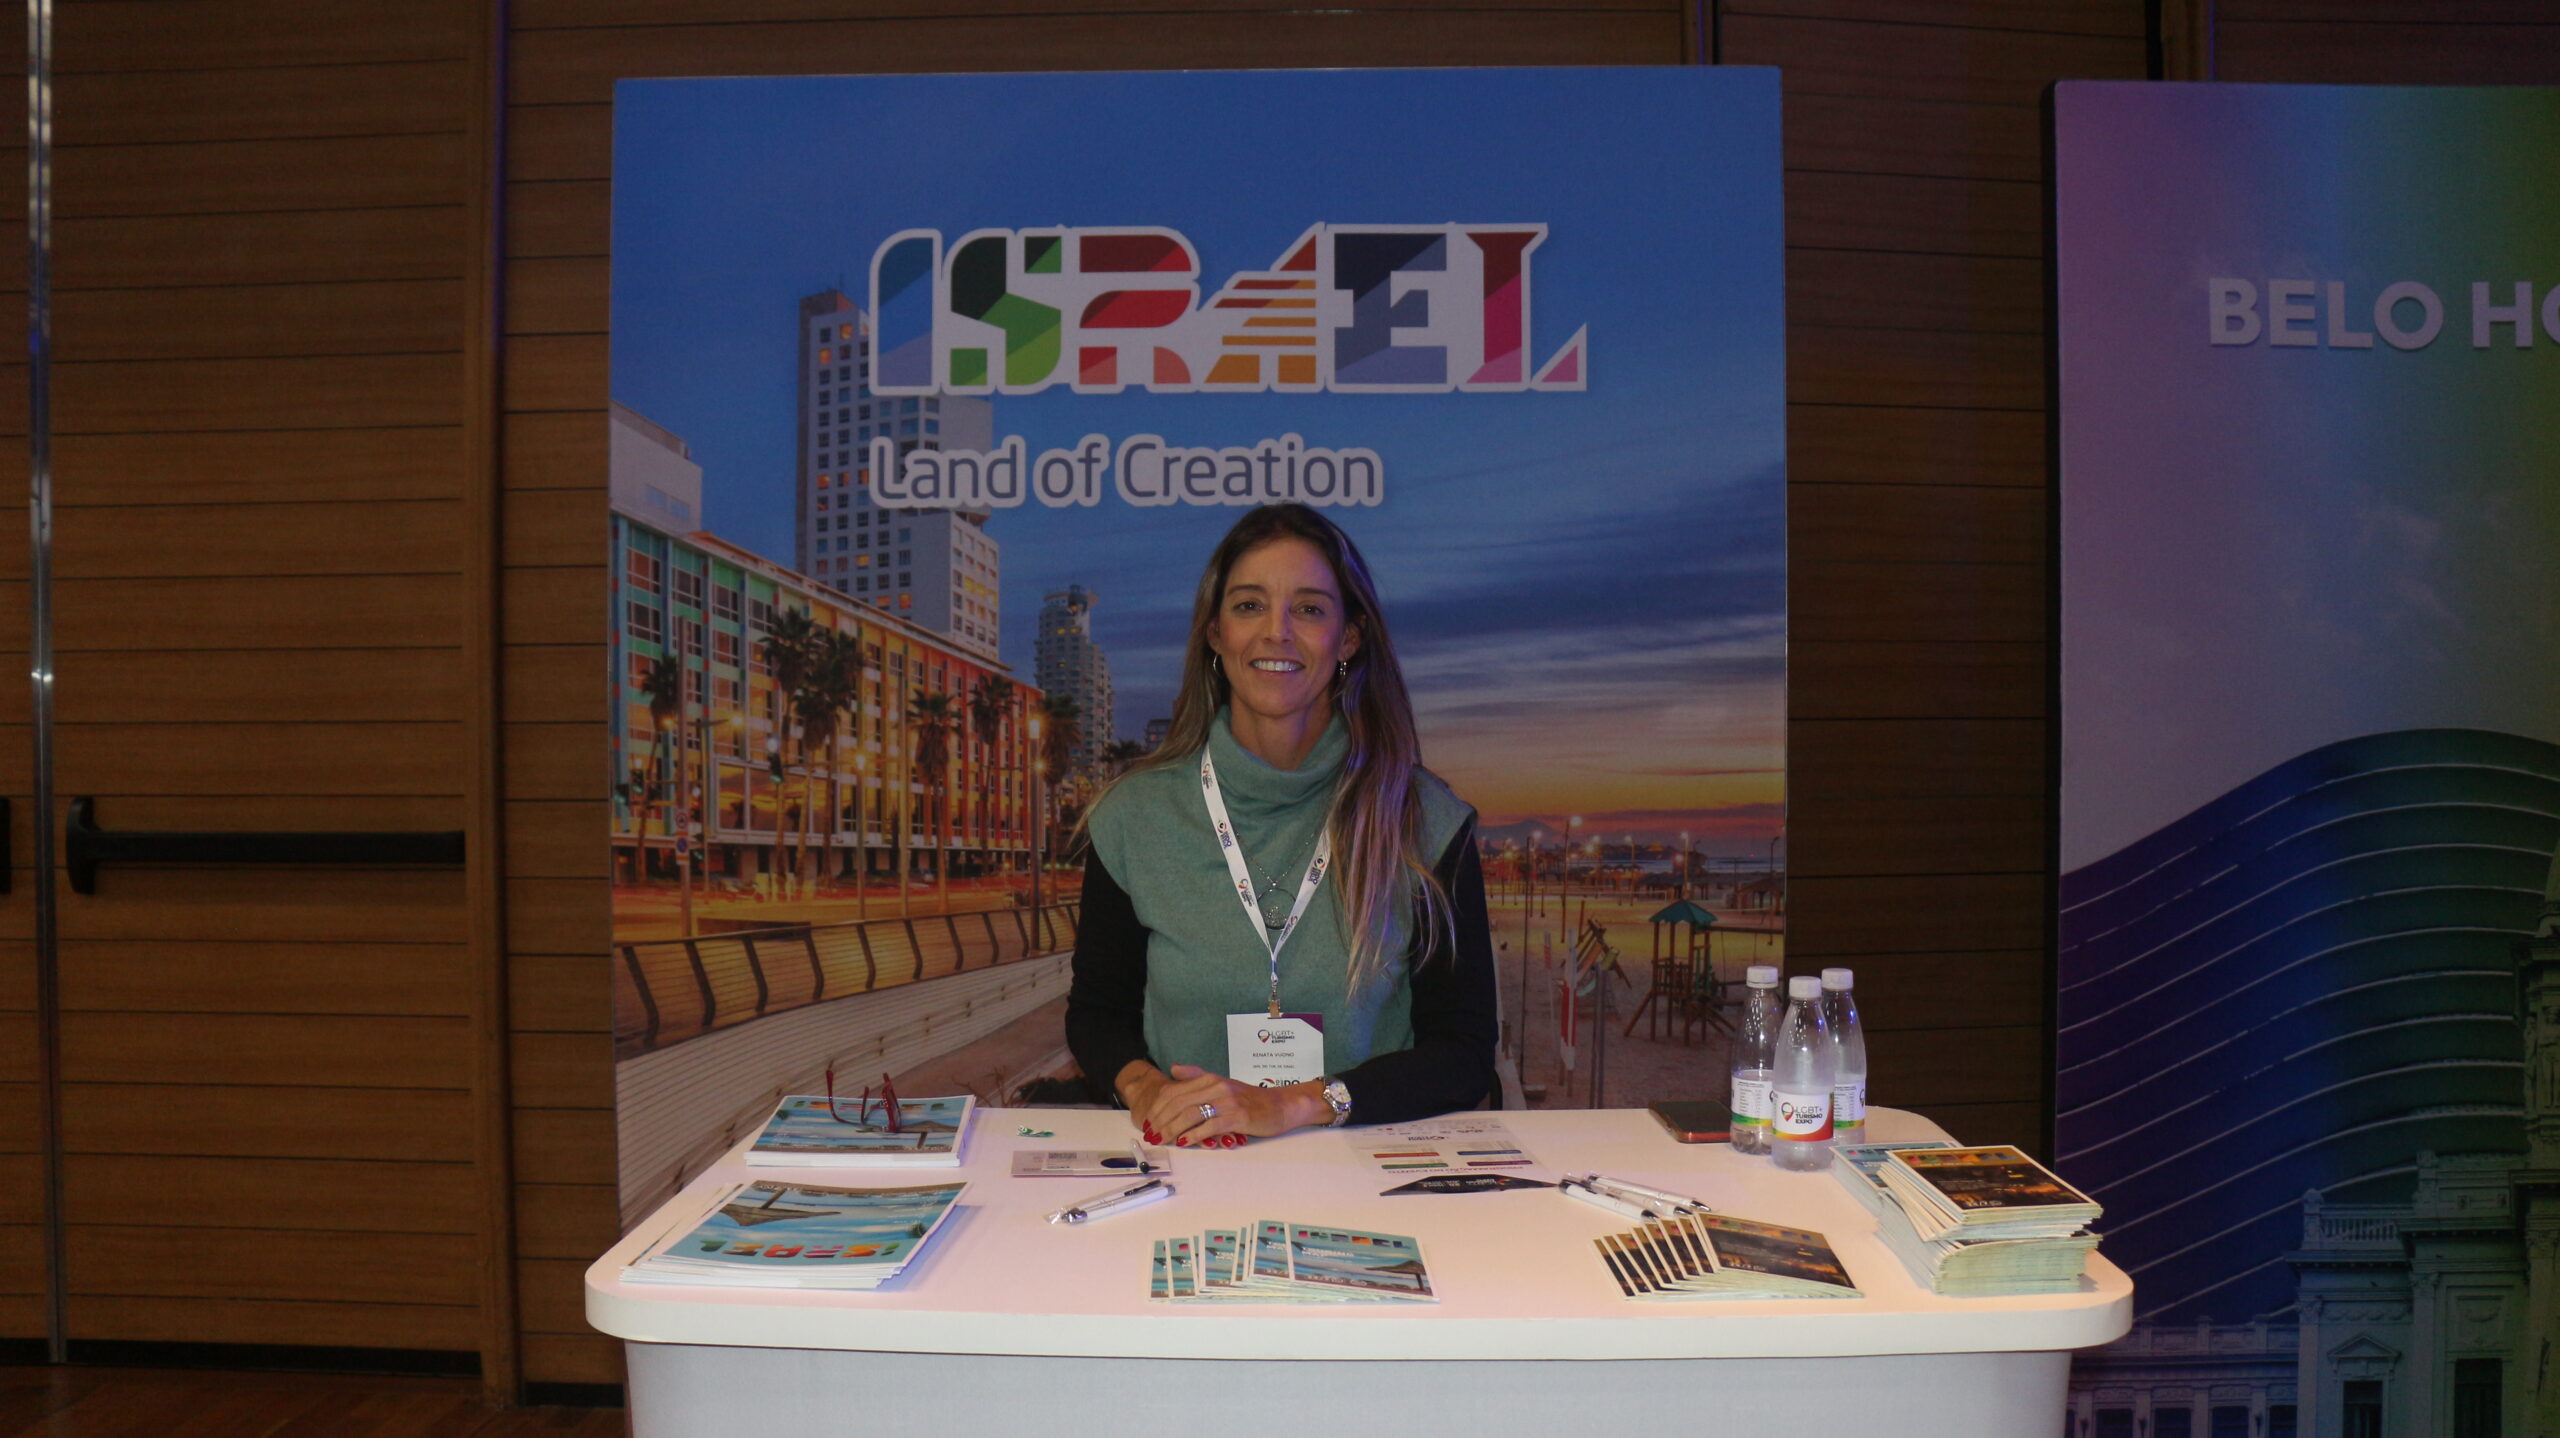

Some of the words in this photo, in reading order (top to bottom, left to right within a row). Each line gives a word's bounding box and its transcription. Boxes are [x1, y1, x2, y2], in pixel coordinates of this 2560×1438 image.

[871, 224, 1585, 393] ISRAEL
[2209, 278, 2444, 350] BELO
[2471, 281, 2560, 349] H
[877, 442, 1018, 499] Land
[1041, 440, 1102, 499] of
[1123, 440, 1377, 499] Creation
